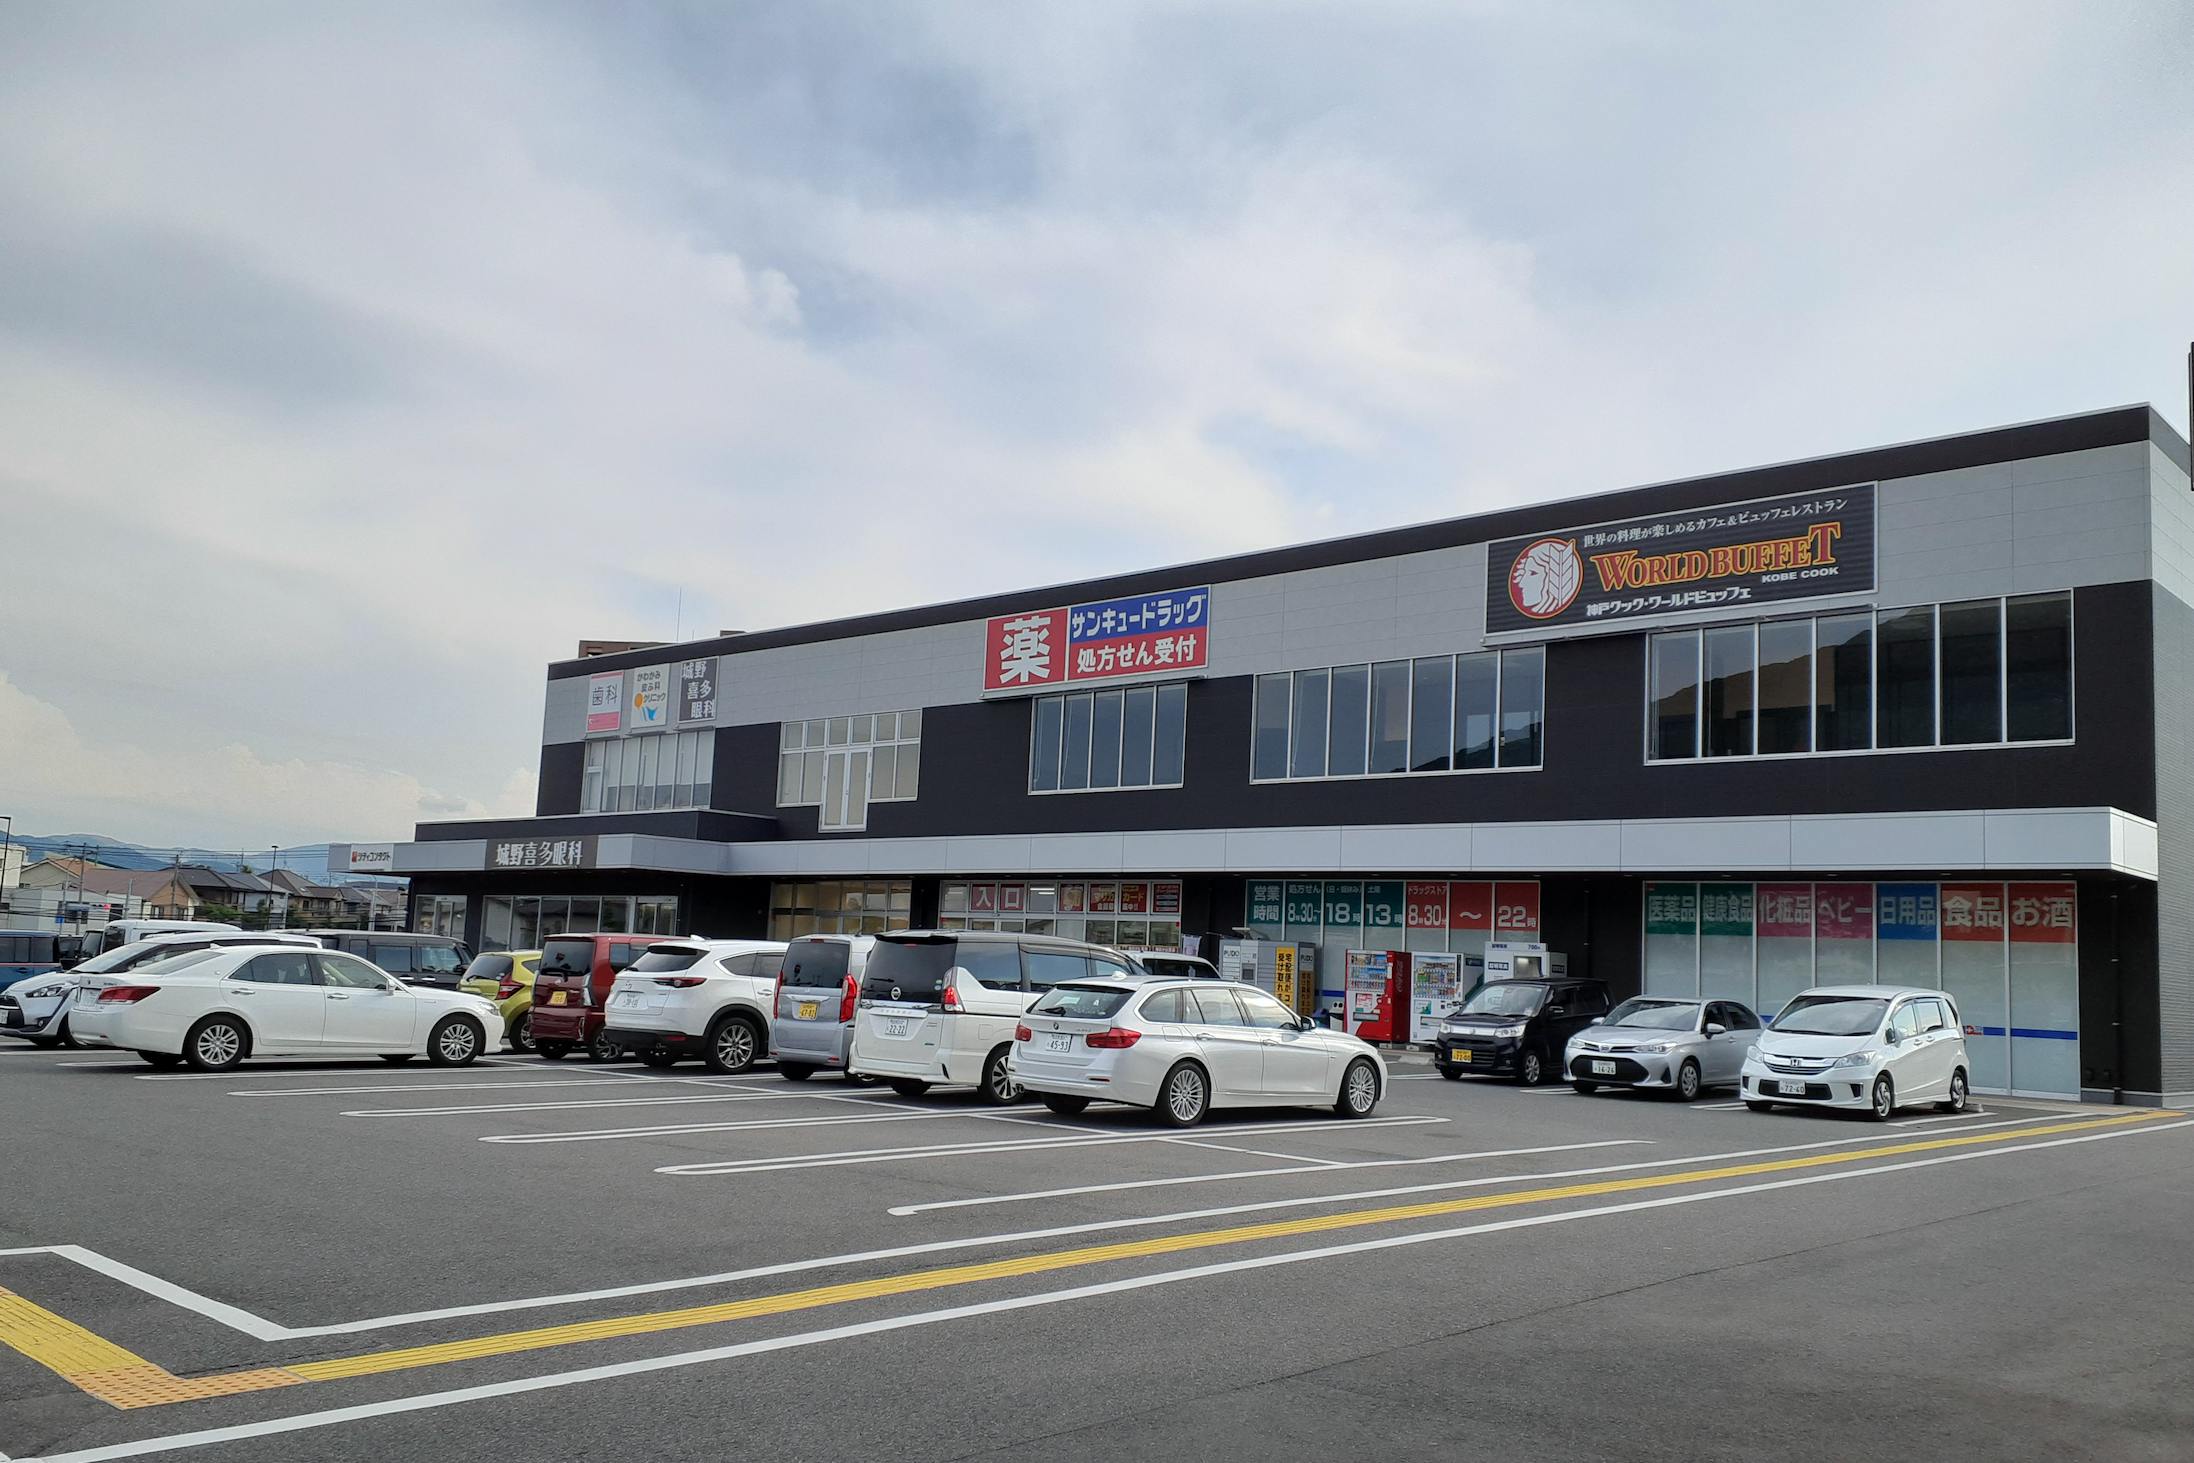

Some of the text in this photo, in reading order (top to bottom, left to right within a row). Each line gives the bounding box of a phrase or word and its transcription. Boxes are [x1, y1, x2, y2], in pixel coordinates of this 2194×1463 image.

[1584, 499, 1848, 547] 世界の料理が楽しめるカフェ&ビュッフェレストラン
[1590, 521, 1841, 592] WORLD BUFFET
[1761, 566, 1840, 584] KOBE COOK
[1586, 586, 1753, 617] 神戸クック・ワールドビュッフェ
[1071, 594, 1207, 639] サンキュードラッグ
[1000, 615, 1051, 684] 薬
[1077, 633, 1197, 674] 処方せん受付
[592, 684, 618, 706] 歯科
[687, 680, 712, 700] 喜多
[690, 699, 715, 719] 眼科
[495, 840, 583, 866] 城野喜多眼科
[975, 886, 1021, 909] 入口
[1253, 885, 1280, 902] 営業
[1253, 904, 1280, 921] 時間
[1648, 895, 1697, 923] 医薬品
[1702, 894, 1753, 923] 健康食品
[1758, 894, 1812, 924] 化粧品
[1817, 895, 1873, 923] ベビー
[1880, 896, 1937, 927] 日用品
[1943, 895, 2004, 929] 食品
[2011, 896, 2074, 929] お酒
